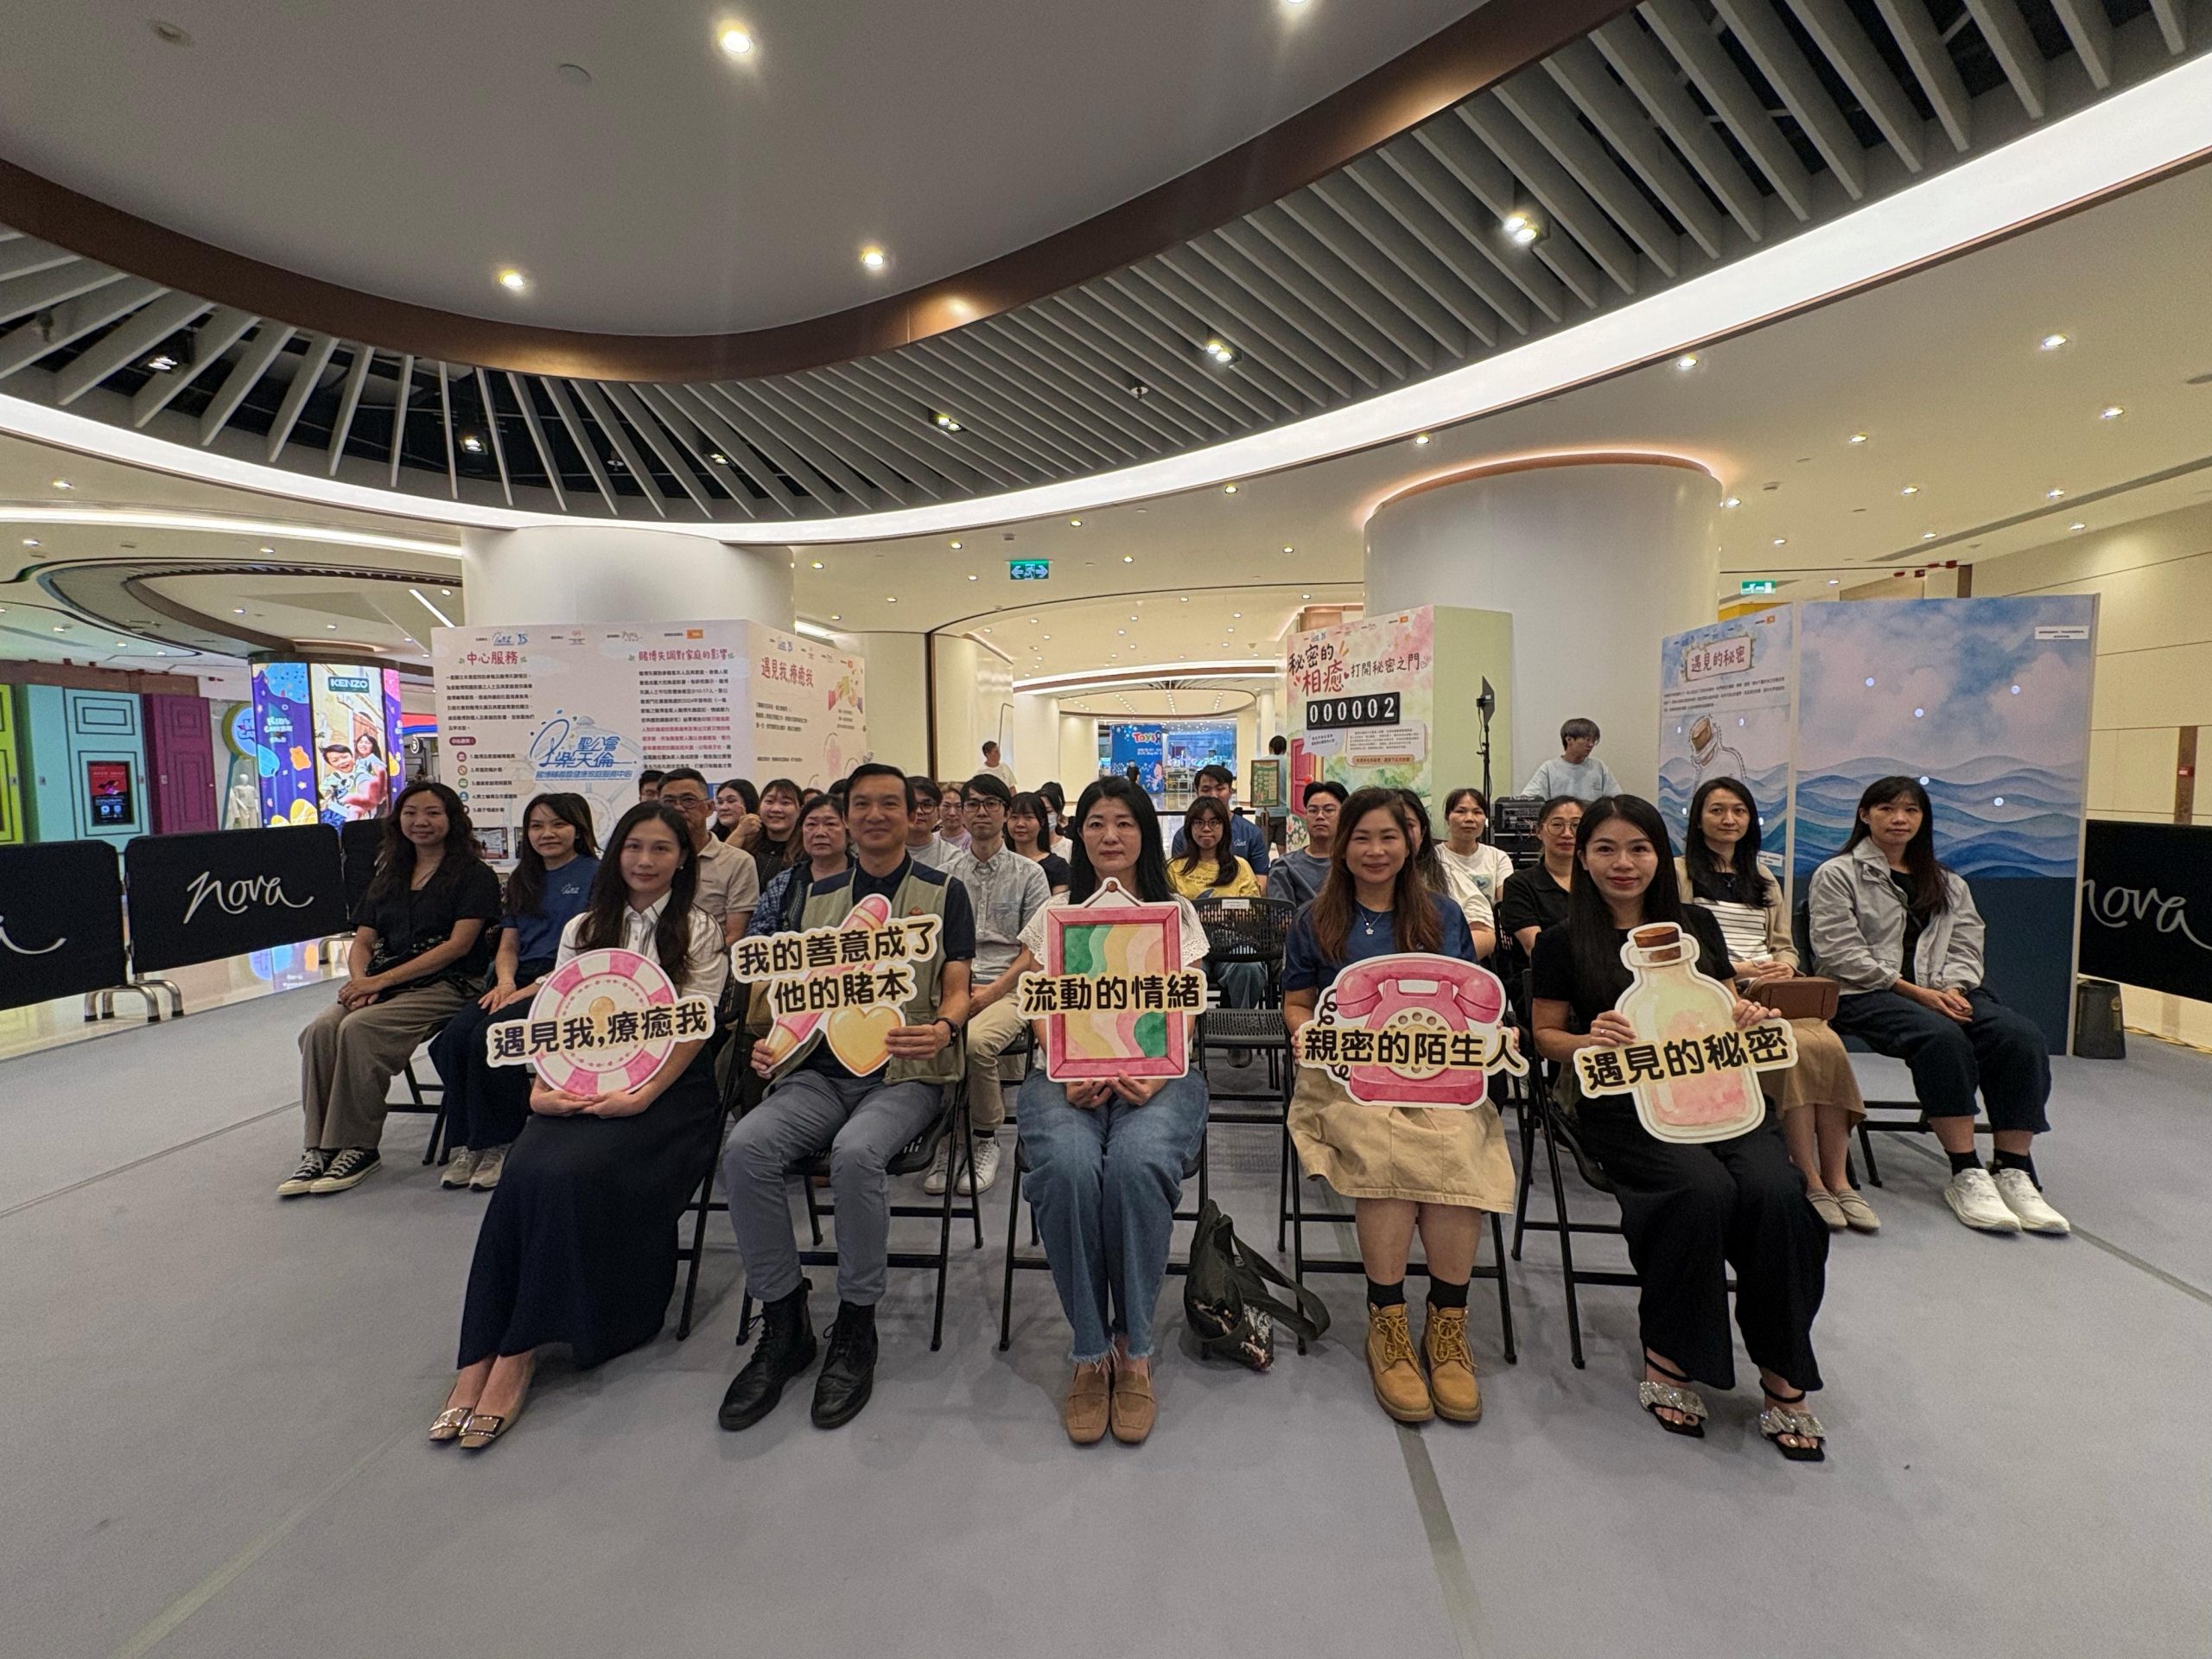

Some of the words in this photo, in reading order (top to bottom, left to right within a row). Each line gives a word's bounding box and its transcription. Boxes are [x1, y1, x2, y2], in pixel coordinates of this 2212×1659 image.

[467, 651, 518, 665] 中心服務
[639, 648, 728, 662] 賭博失調對家庭的影響
[1288, 643, 1334, 676] 秘密的
[1351, 652, 1420, 678] 打開秘密之門
[1691, 645, 1745, 673] 遇見的秘密
[330, 678, 368, 689] KENZO
[1309, 696, 1395, 723] 000002
[577, 736, 620, 751] 聖公會
[737, 921, 936, 976] 我的善意成了
[774, 971, 909, 1014] 他的賭本
[1024, 974, 1200, 1012] 流動的情緒
[1305, 1027, 1522, 1070] 親密的陌生人
[1583, 1026, 1789, 1090] 遇見的秘密
